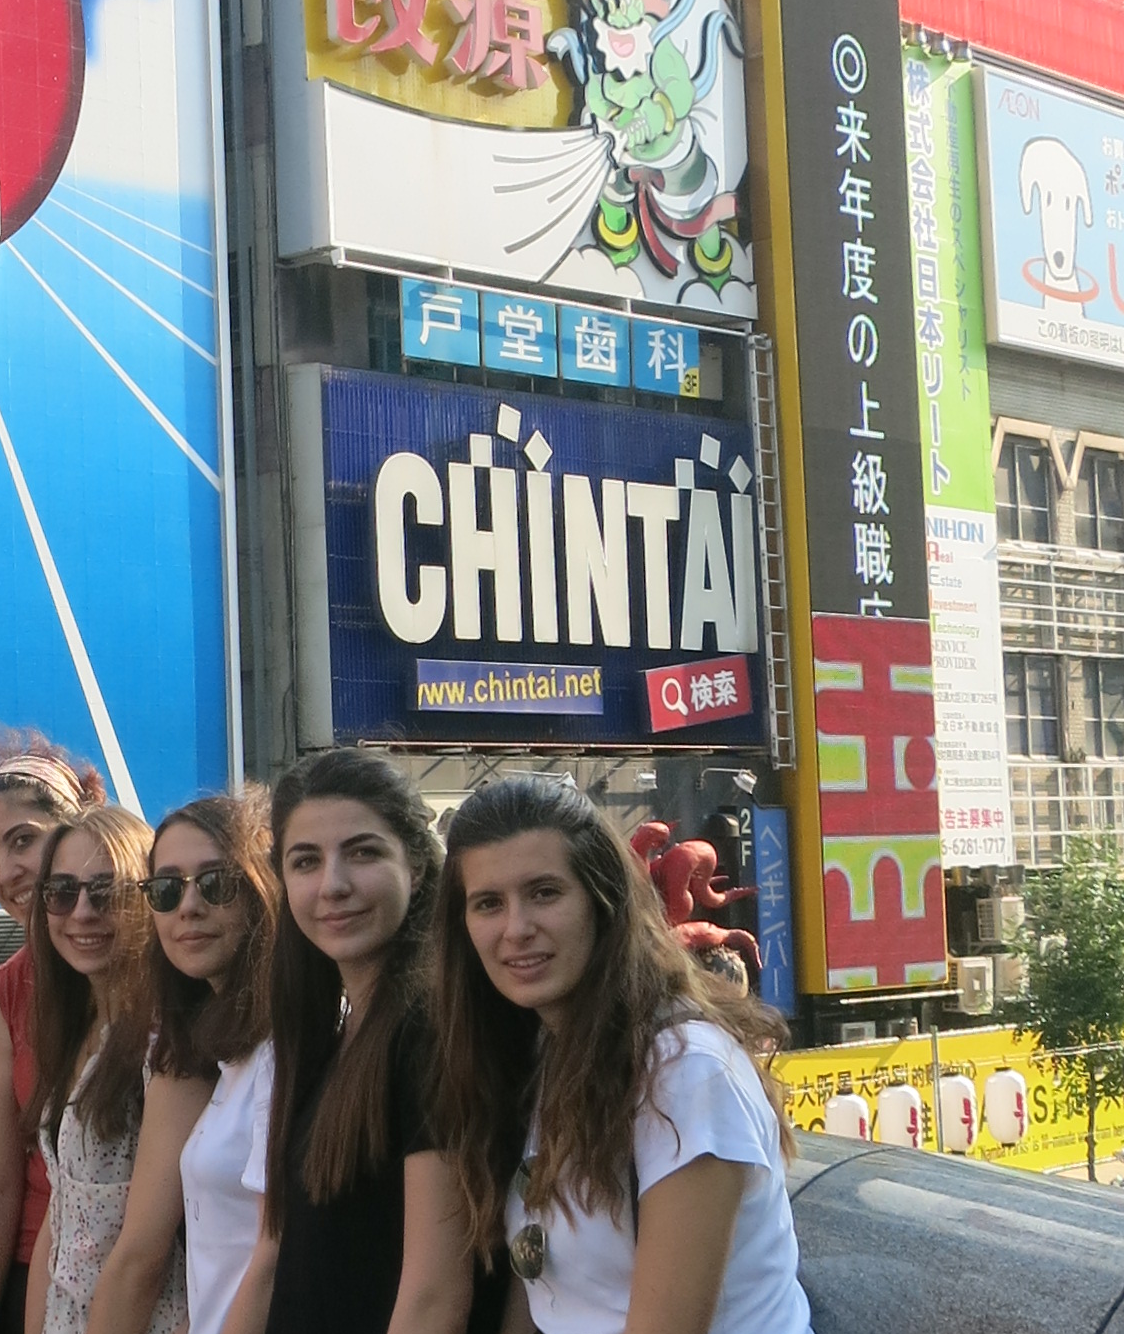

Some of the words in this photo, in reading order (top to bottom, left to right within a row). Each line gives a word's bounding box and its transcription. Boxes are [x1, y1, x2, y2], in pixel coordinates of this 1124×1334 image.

[907, 61, 950, 496] 株式会社日本リート
[375, 402, 758, 653] CHINTAI
[690, 670, 738, 712] 検索
